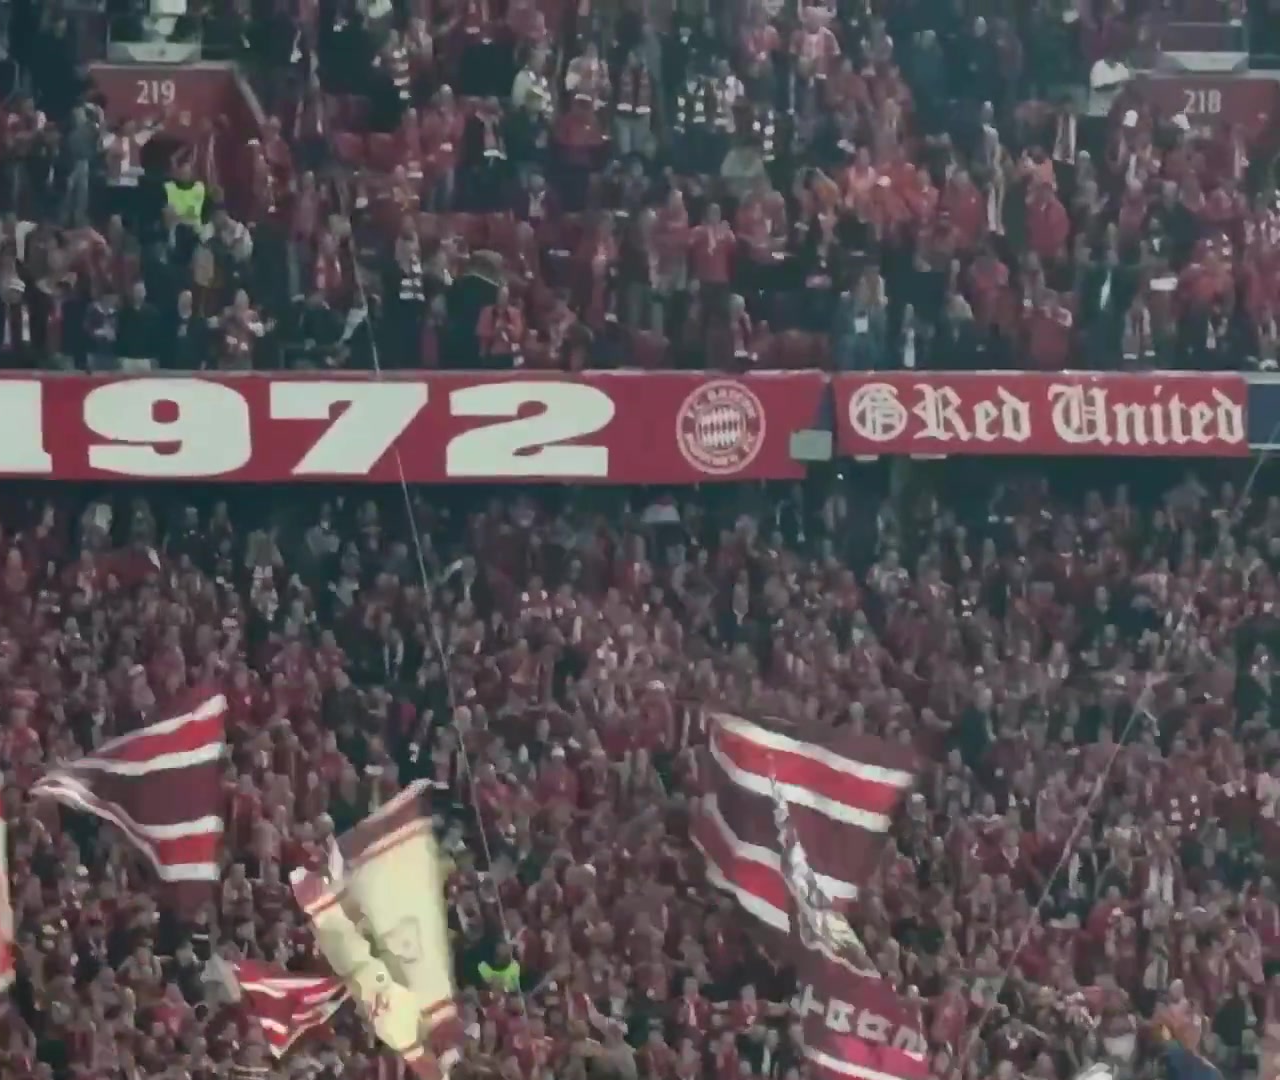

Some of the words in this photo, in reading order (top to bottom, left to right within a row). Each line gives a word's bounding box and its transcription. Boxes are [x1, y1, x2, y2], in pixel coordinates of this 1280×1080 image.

[136, 80, 175, 105] 219
[913, 384, 1032, 441] Red
[1048, 384, 1246, 446] United
